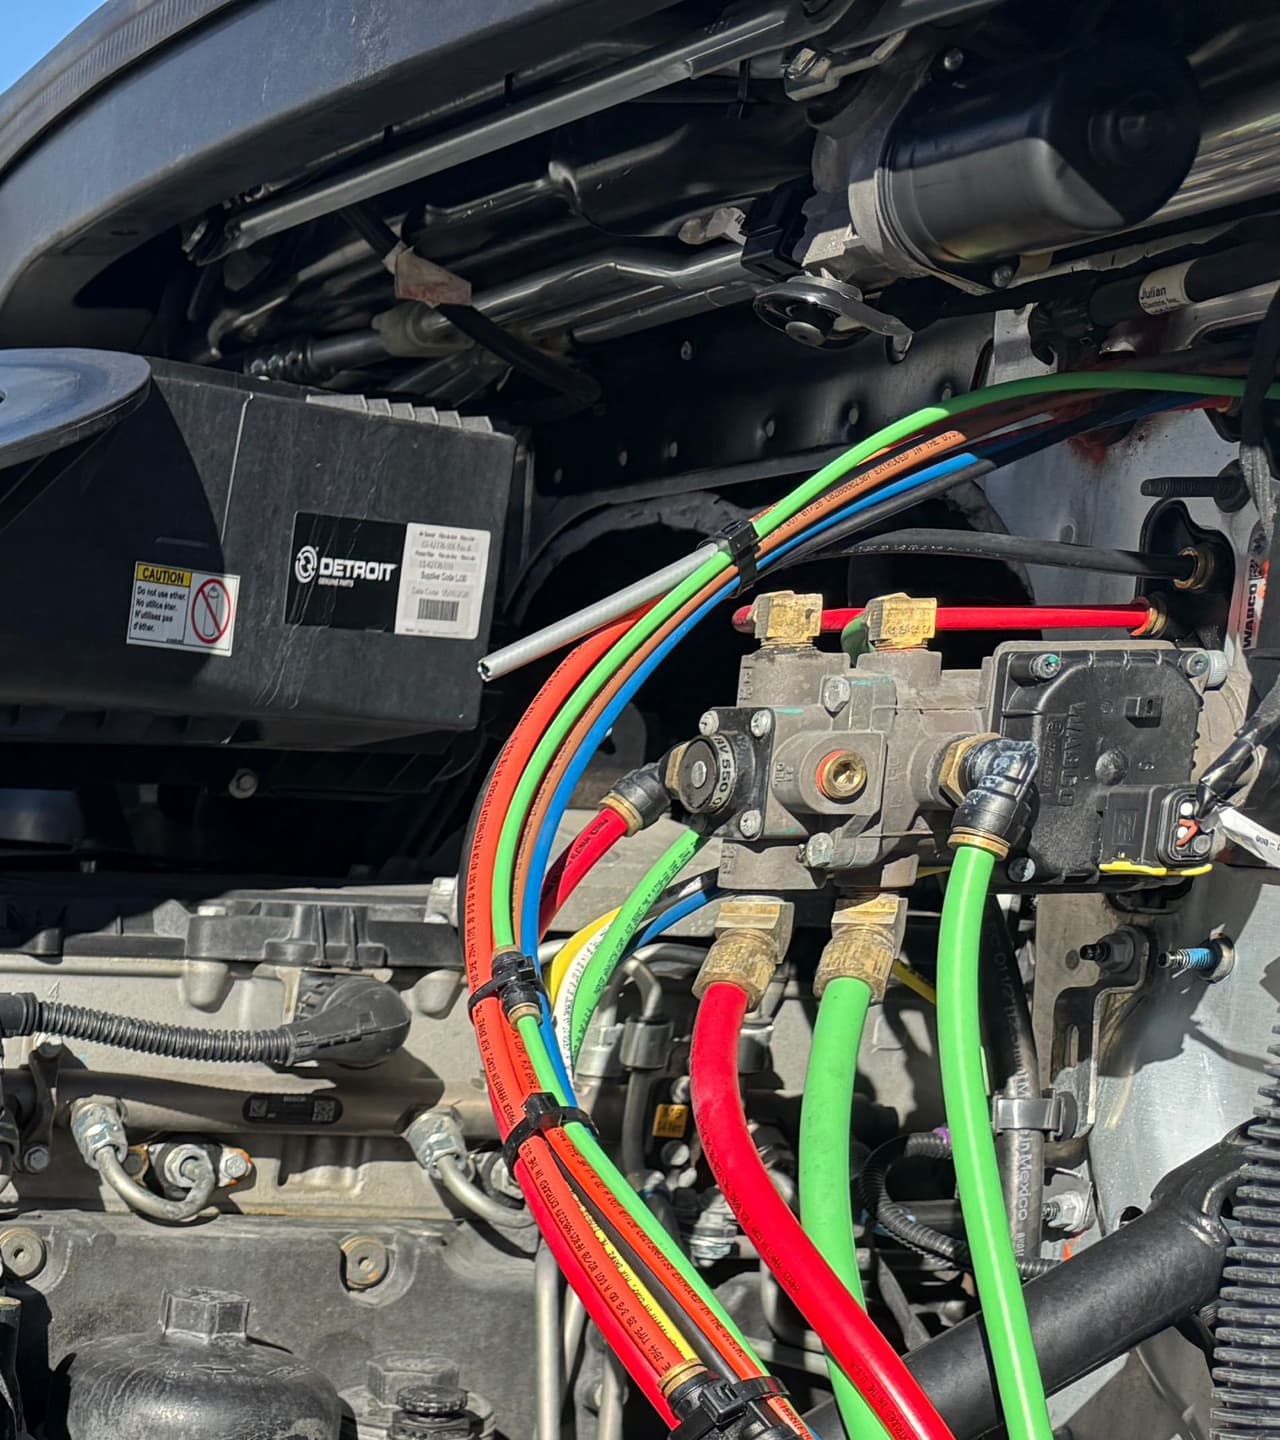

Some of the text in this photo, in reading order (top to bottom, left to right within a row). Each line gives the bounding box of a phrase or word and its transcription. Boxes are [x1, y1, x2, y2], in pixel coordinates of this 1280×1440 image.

[142, 567, 184, 584] CAUTION
[319, 557, 398, 581] DETROIT
[136, 599, 144, 607] No
[137, 587, 145, 595] Do
[147, 588, 156, 596] not
[169, 591, 186, 600] ether.
[1242, 582, 1258, 648] WABCO
[720, 757, 734, 793] 550
[1017, 1154, 1032, 1221] Mexico
[633, 1325, 651, 1345] TYPE
